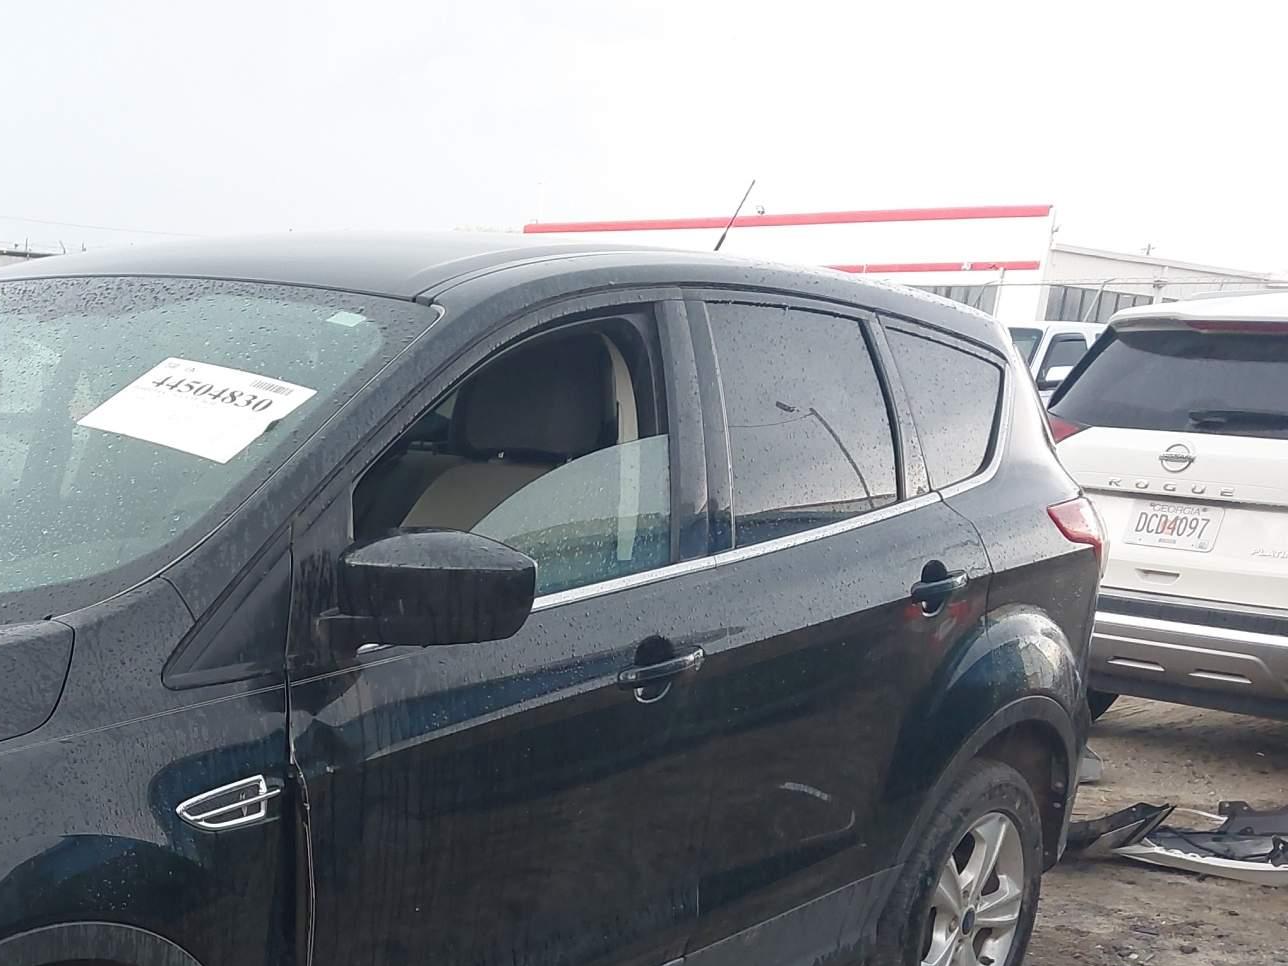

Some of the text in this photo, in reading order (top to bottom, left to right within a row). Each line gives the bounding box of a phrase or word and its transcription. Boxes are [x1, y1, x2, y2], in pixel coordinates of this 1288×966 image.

[151, 375, 273, 412] 44504830
[1108, 477, 1236, 497] ROGUE
[1152, 503, 1201, 516] GEORGIA
[1134, 511, 1211, 539] DCD4097
